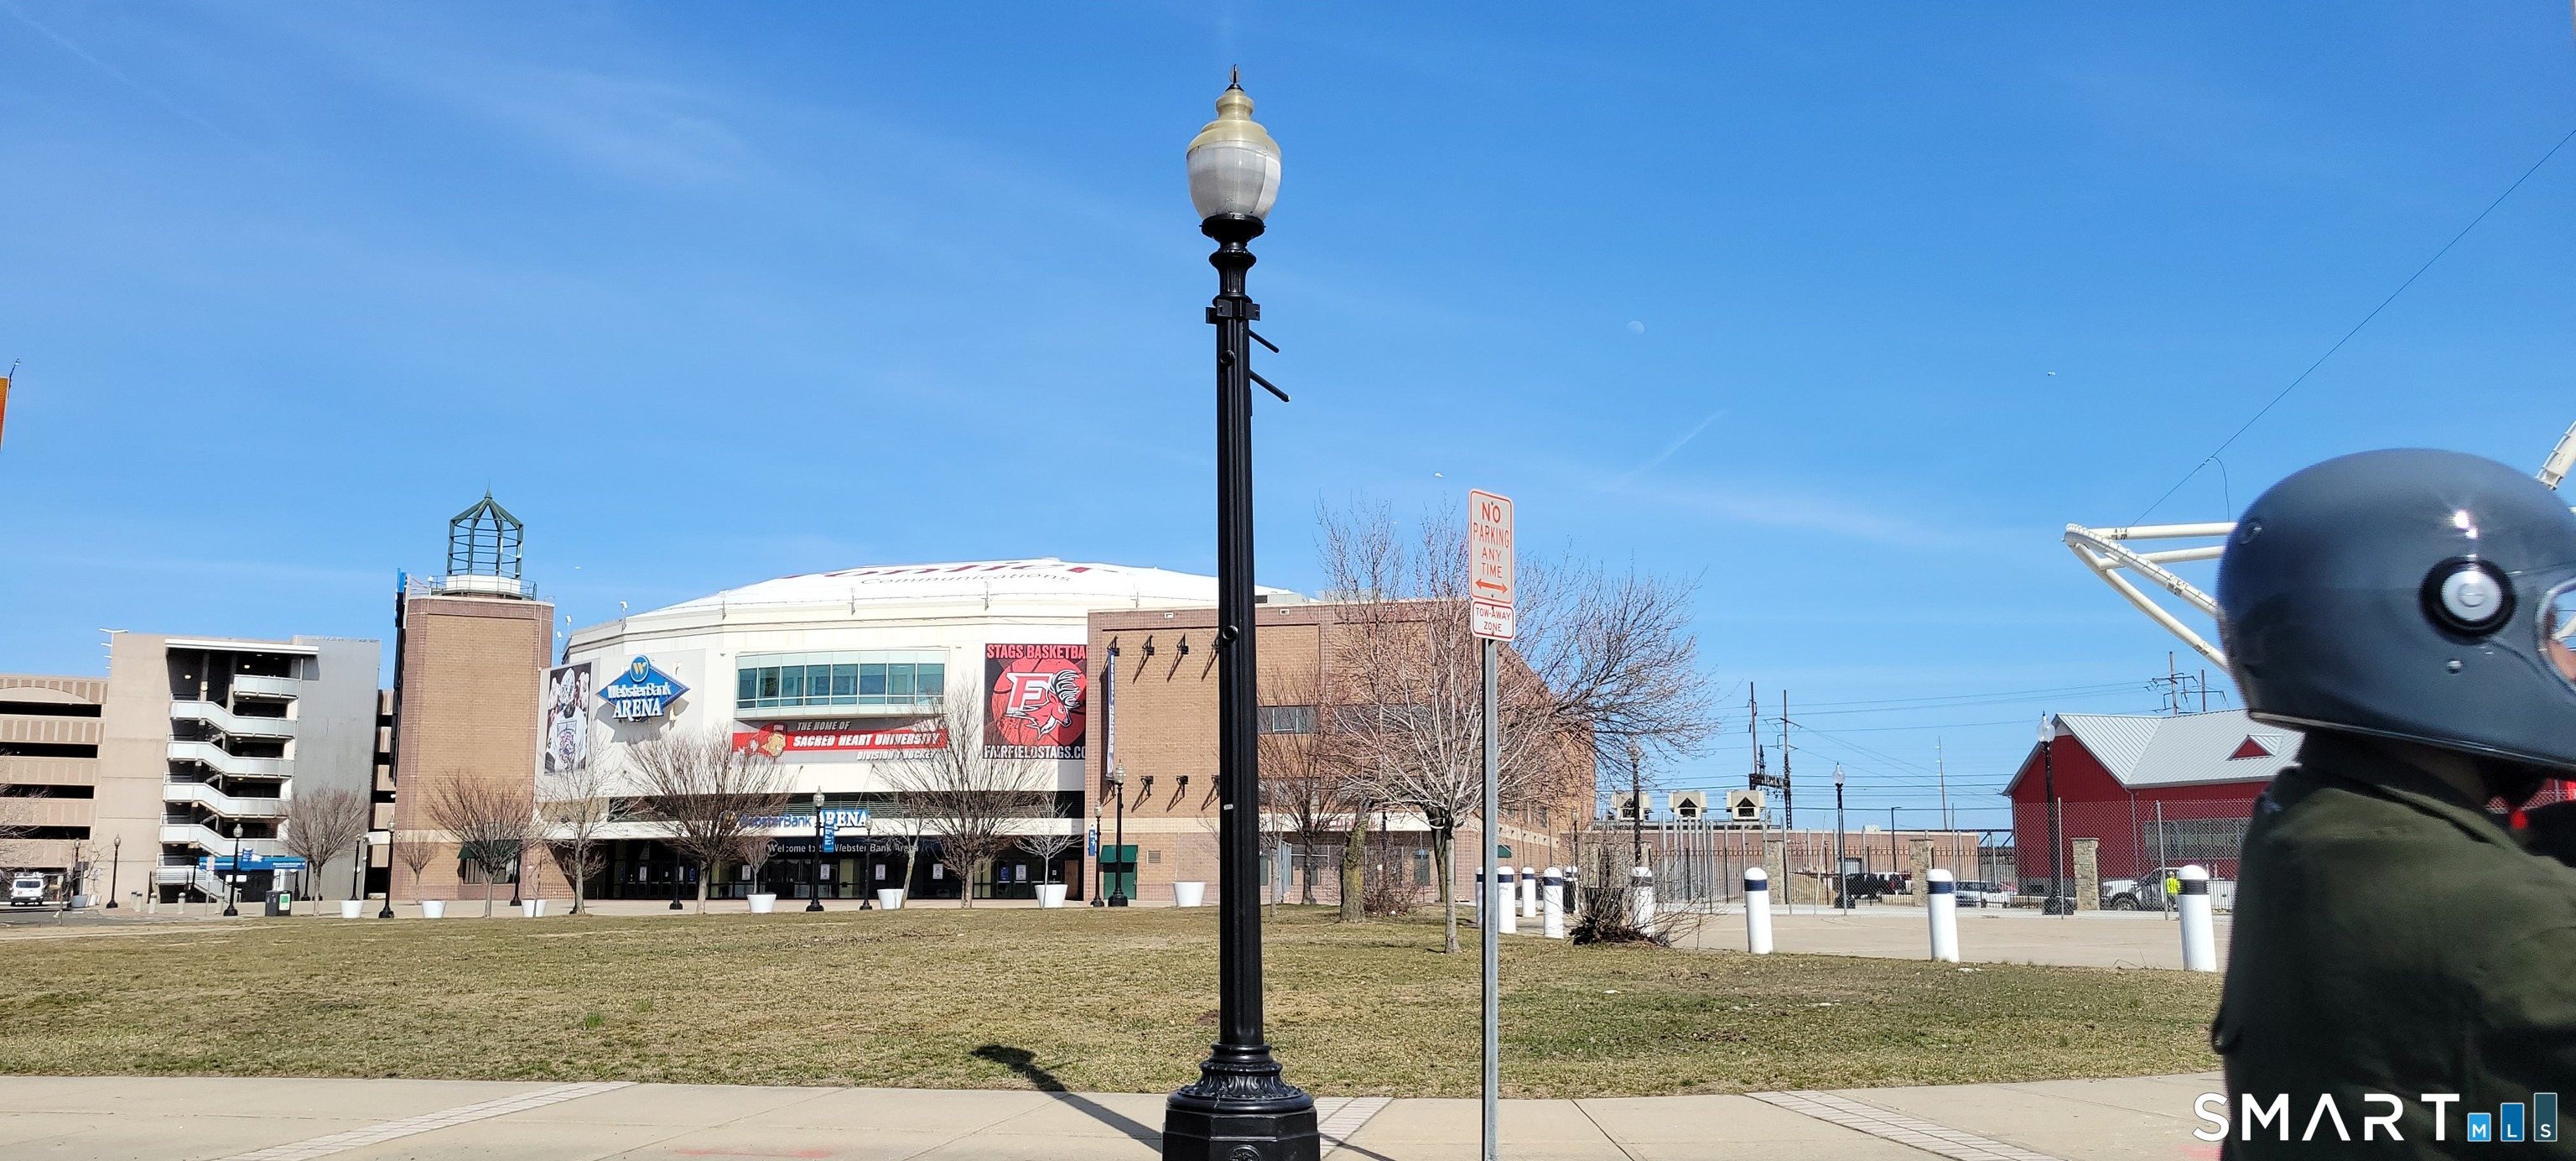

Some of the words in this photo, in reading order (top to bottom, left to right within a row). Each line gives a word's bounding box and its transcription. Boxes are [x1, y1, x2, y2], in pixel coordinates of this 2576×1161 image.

[1482, 502, 1501, 523] NO
[1473, 523, 1509, 548] PARKING
[1482, 548, 1502, 562] ANY
[1481, 563, 1503, 579] TIME
[862, 572, 1071, 585] Communications
[1476, 607, 1511, 621] TOW-AWAY
[1483, 622, 1503, 633] ZONE
[987, 644, 1024, 659] STAGS
[612, 698, 663, 722] ARENA
[797, 722, 812, 731] THE
[813, 721, 836, 731] HOME
[839, 721, 850, 730] OF
[792, 734, 835, 747] SACRED
[838, 733, 873, 747] HEART
[875, 732, 940, 746] UNIVERSITY
[856, 750, 895, 761] DIVISION
[870, 843, 892, 853] Bank
